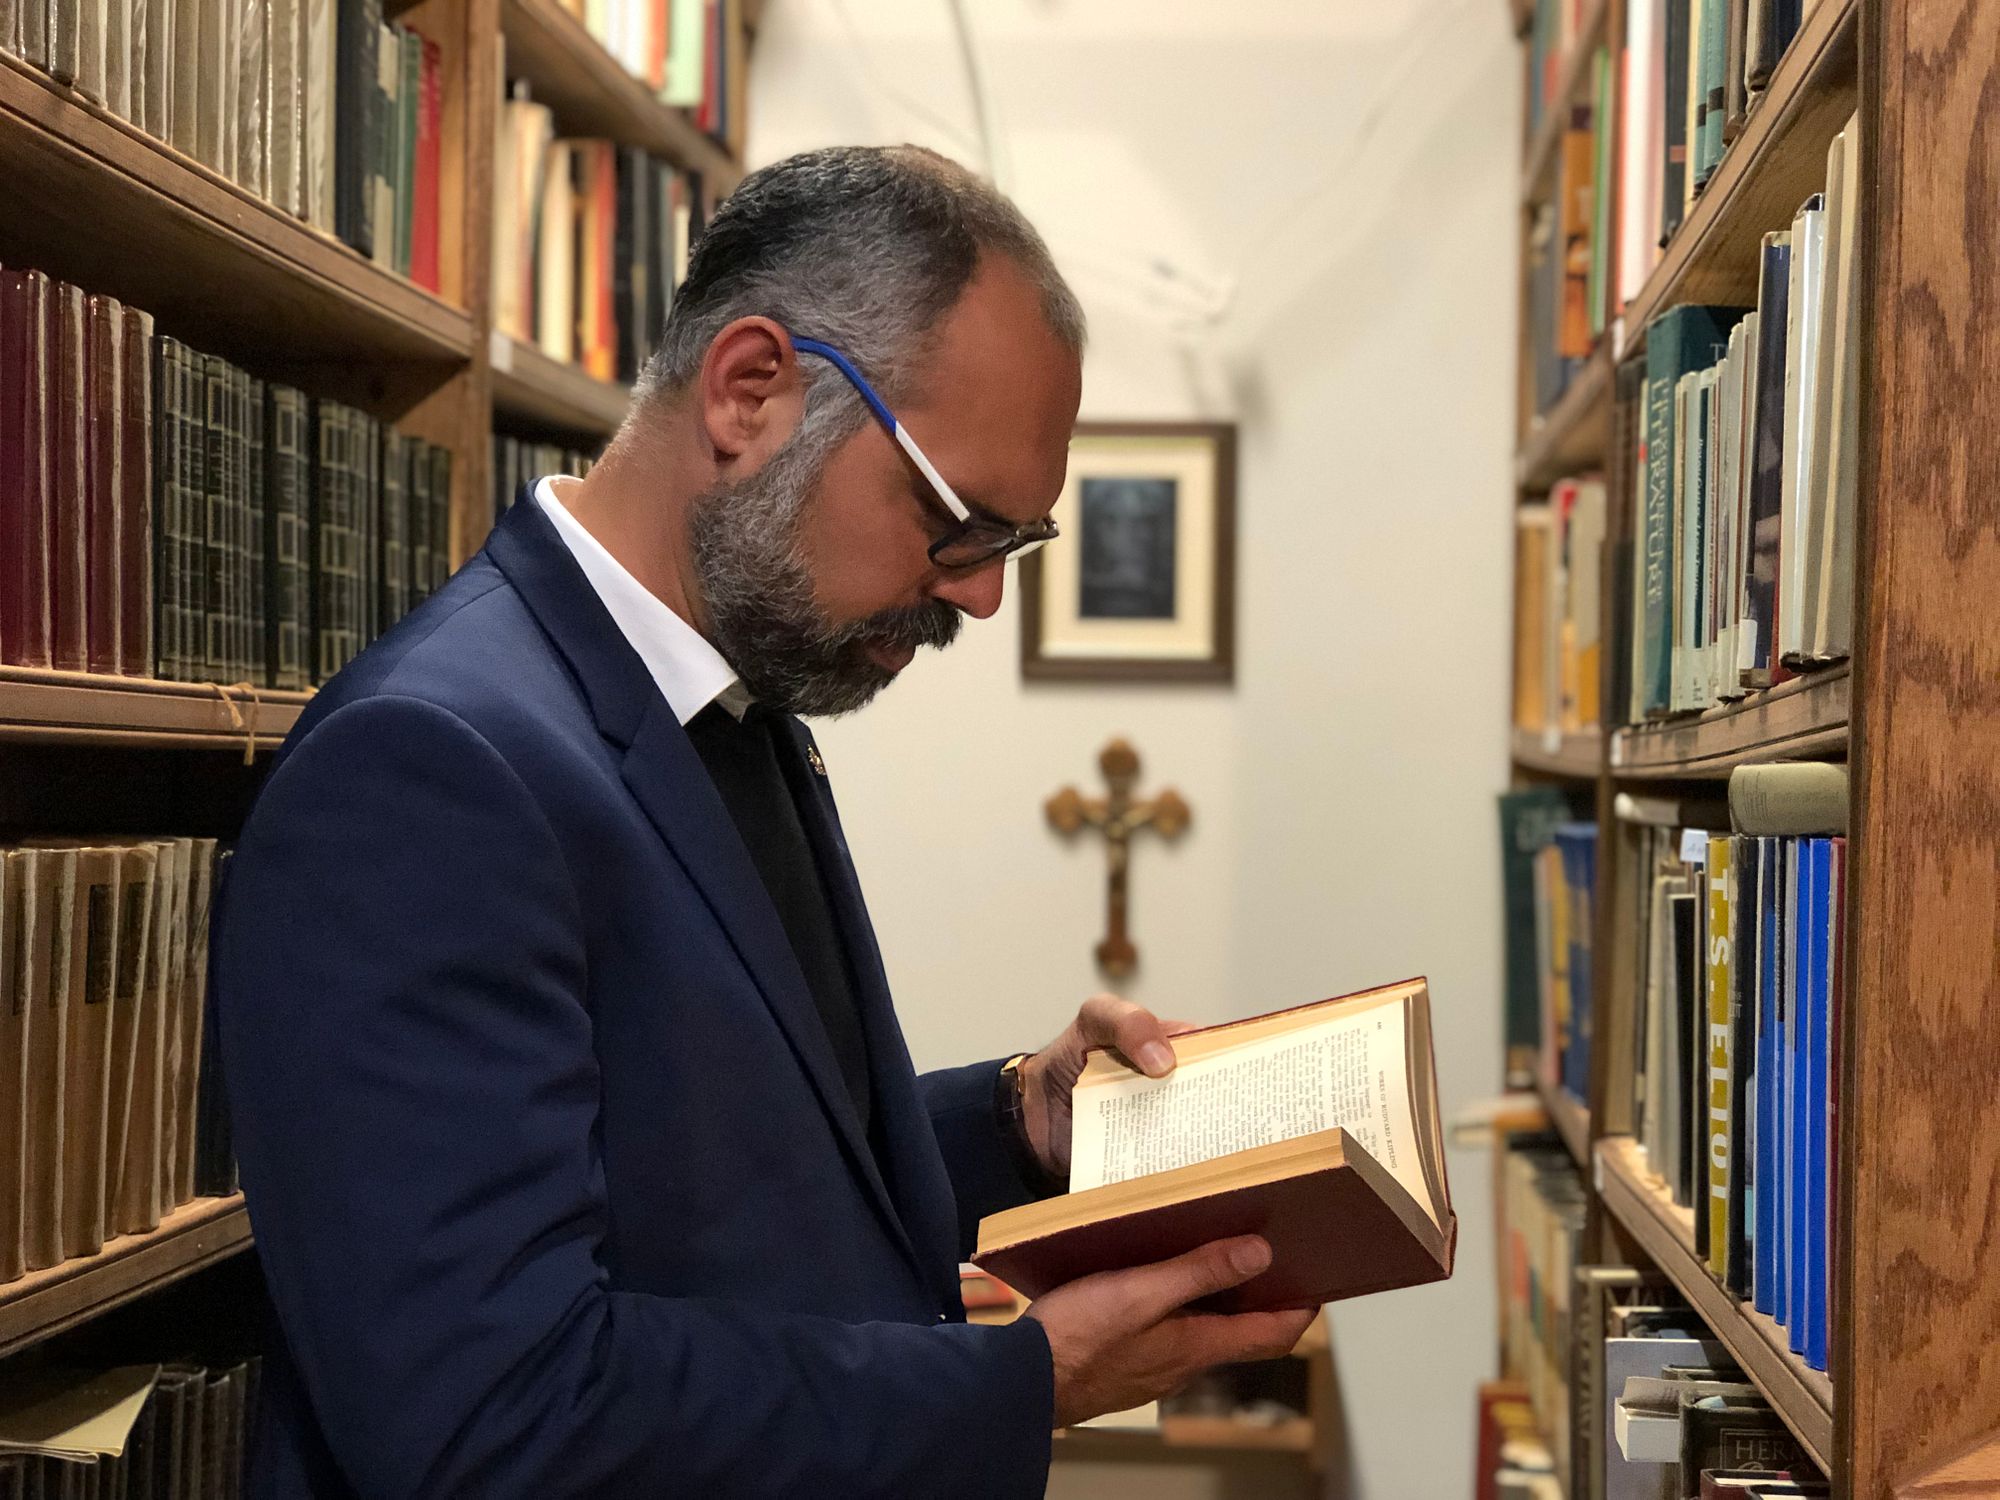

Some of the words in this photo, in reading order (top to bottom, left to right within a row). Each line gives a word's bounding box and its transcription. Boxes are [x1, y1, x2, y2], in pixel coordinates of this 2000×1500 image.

[1647, 378, 1662, 607] LITERATURE
[1380, 1104, 1391, 1137] RUDYARD
[1386, 1139, 1397, 1169] KIPLING
